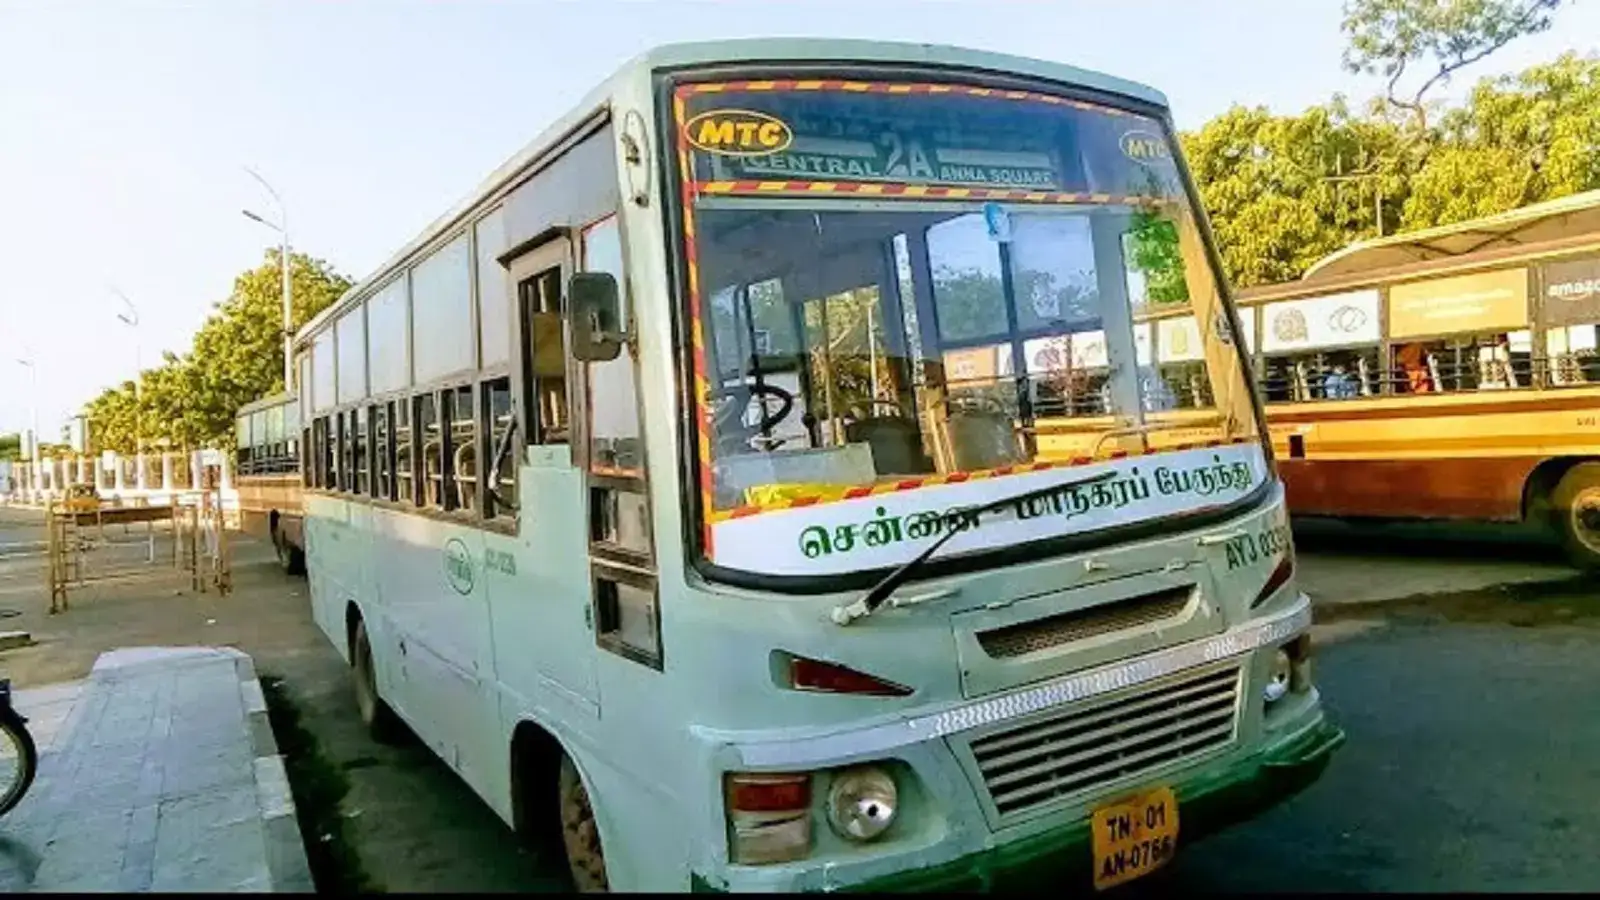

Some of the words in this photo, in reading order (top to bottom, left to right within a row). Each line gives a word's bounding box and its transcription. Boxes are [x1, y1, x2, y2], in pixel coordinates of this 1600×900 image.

[699, 120, 781, 147] MTC
[1128, 139, 1168, 159] MTC
[748, 153, 880, 177] CENTRAL
[881, 131, 934, 178] 2A
[940, 165, 986, 182] ANNA
[799, 504, 979, 558] சென்னை
[1154, 454, 1251, 496] பேருந்து
[1226, 533, 1258, 570] AYJ
